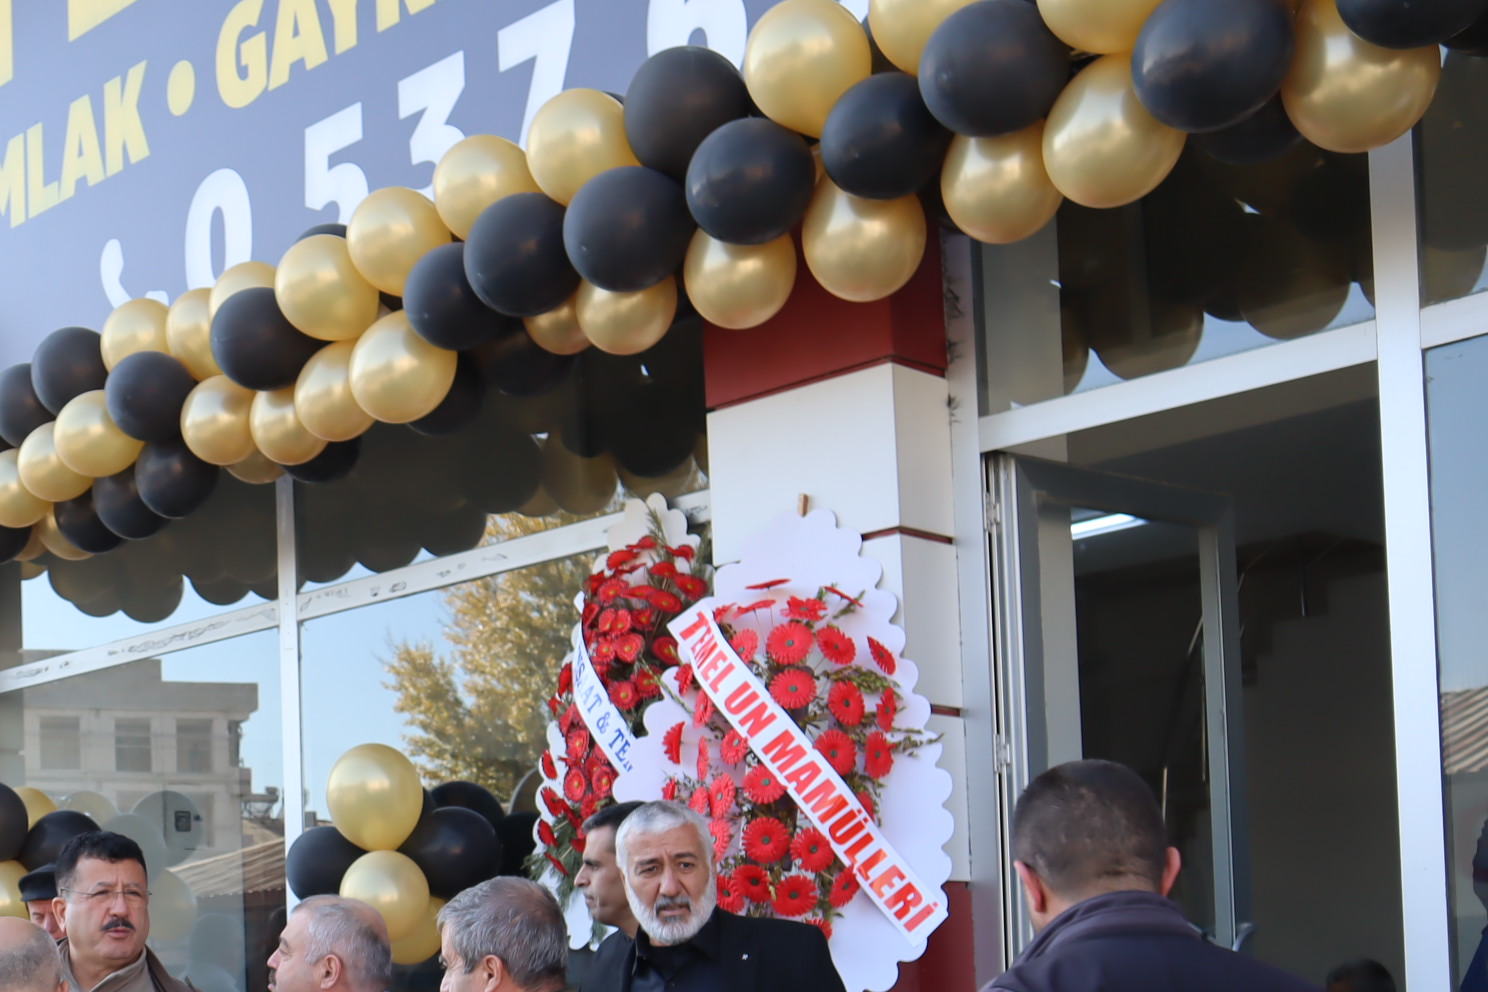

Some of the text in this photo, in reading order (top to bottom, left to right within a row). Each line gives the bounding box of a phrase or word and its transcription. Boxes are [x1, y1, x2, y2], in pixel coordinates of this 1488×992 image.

[596, 711, 610, 735] &
[608, 728, 633, 772] TE
[679, 611, 938, 932] TEMEL UN MAMÜLLERİ
